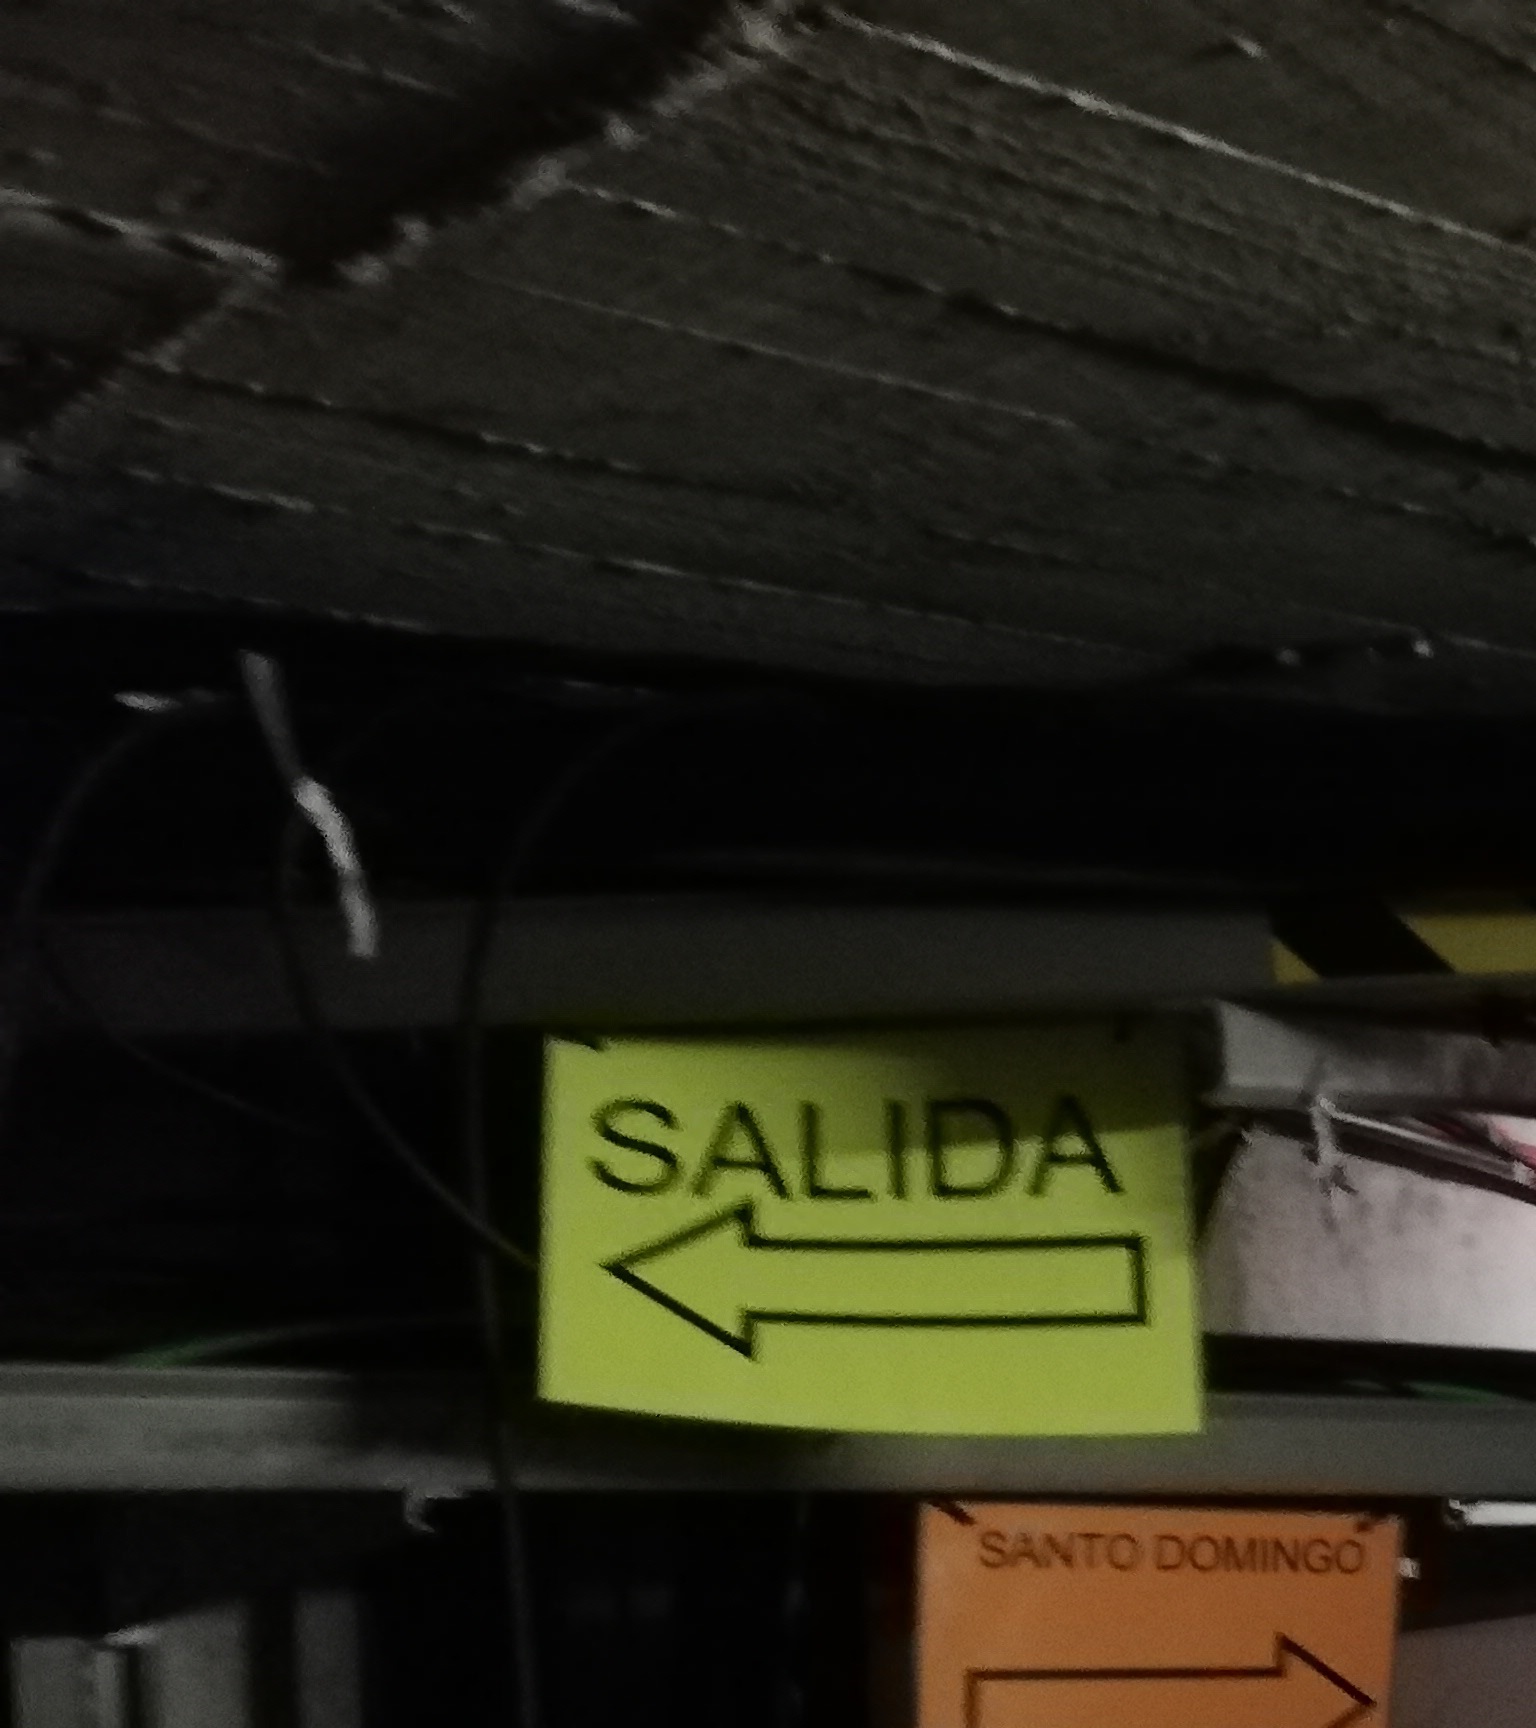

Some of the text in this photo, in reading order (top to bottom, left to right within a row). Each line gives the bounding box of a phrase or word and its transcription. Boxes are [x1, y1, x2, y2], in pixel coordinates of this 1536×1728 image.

[590, 1096, 1124, 1200] SALIDA
[979, 1531, 1365, 1575] SANTO DOMINGO
